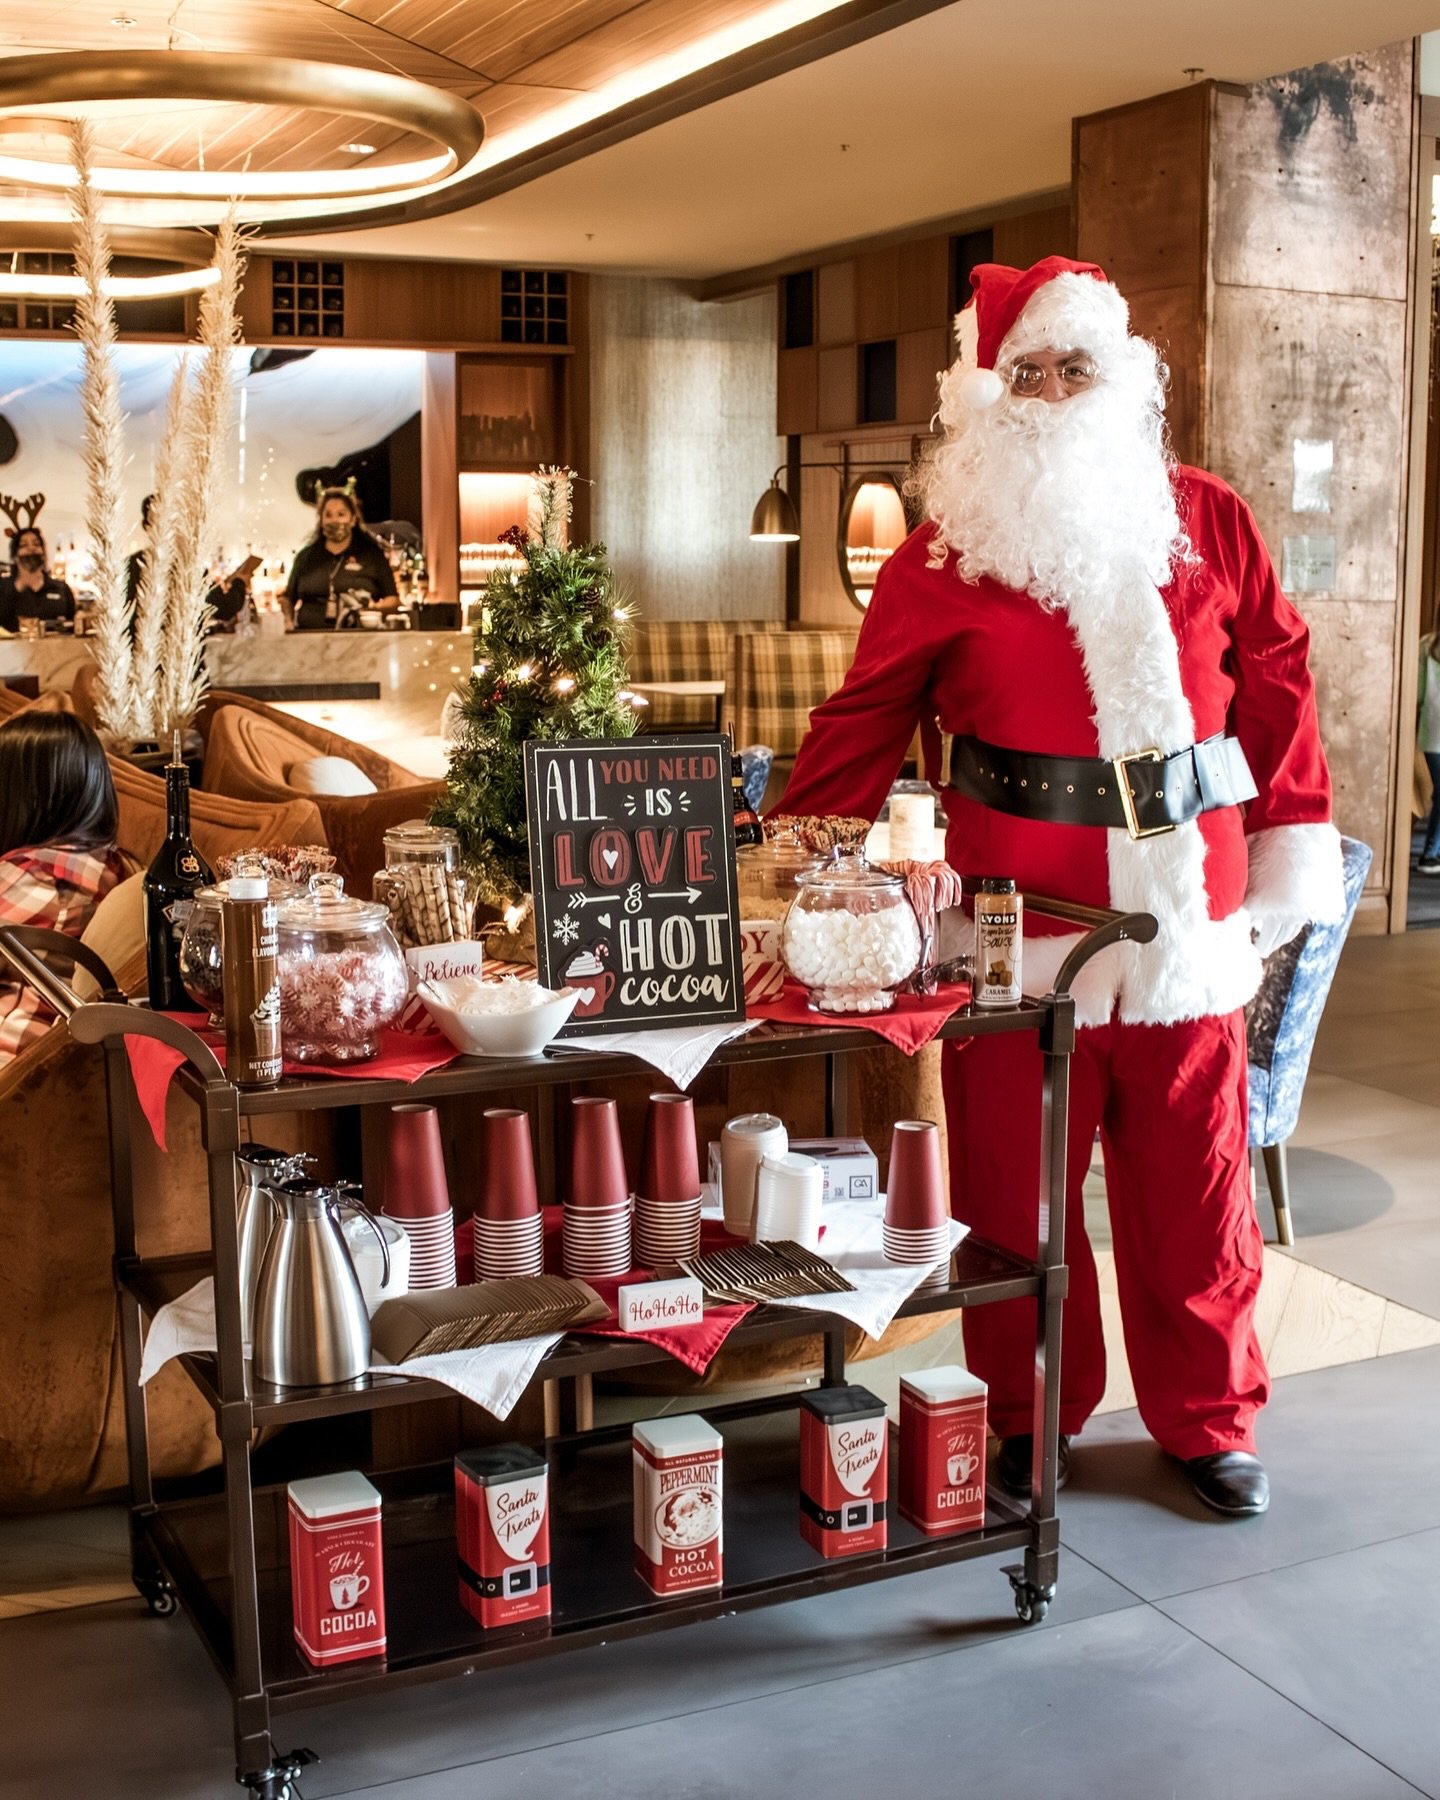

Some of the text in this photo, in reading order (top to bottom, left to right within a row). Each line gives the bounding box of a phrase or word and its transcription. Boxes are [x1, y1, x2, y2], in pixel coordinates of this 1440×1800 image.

[546, 756, 717, 821] ALL YOU NEED
[645, 788, 672, 816] IS
[553, 826, 717, 890] LOVE
[624, 883, 642, 914] &
[981, 914, 1016, 924] LYONS
[619, 914, 728, 973] HOT
[424, 959, 480, 981] Believe
[620, 973, 729, 1006] cocoa
[838, 1428, 877, 1457] Santa
[838, 1447, 880, 1479] Treats
[660, 1465, 718, 1495] PEPPERMINT
[496, 1488, 539, 1520] Santa
[937, 1485, 982, 1509] COCOA
[497, 1507, 541, 1543] Treats
[328, 1551, 362, 1573] Hot
[669, 1560, 715, 1578] COCOA
[675, 1548, 707, 1564] HOT
[320, 1609, 377, 1636] COCOA
